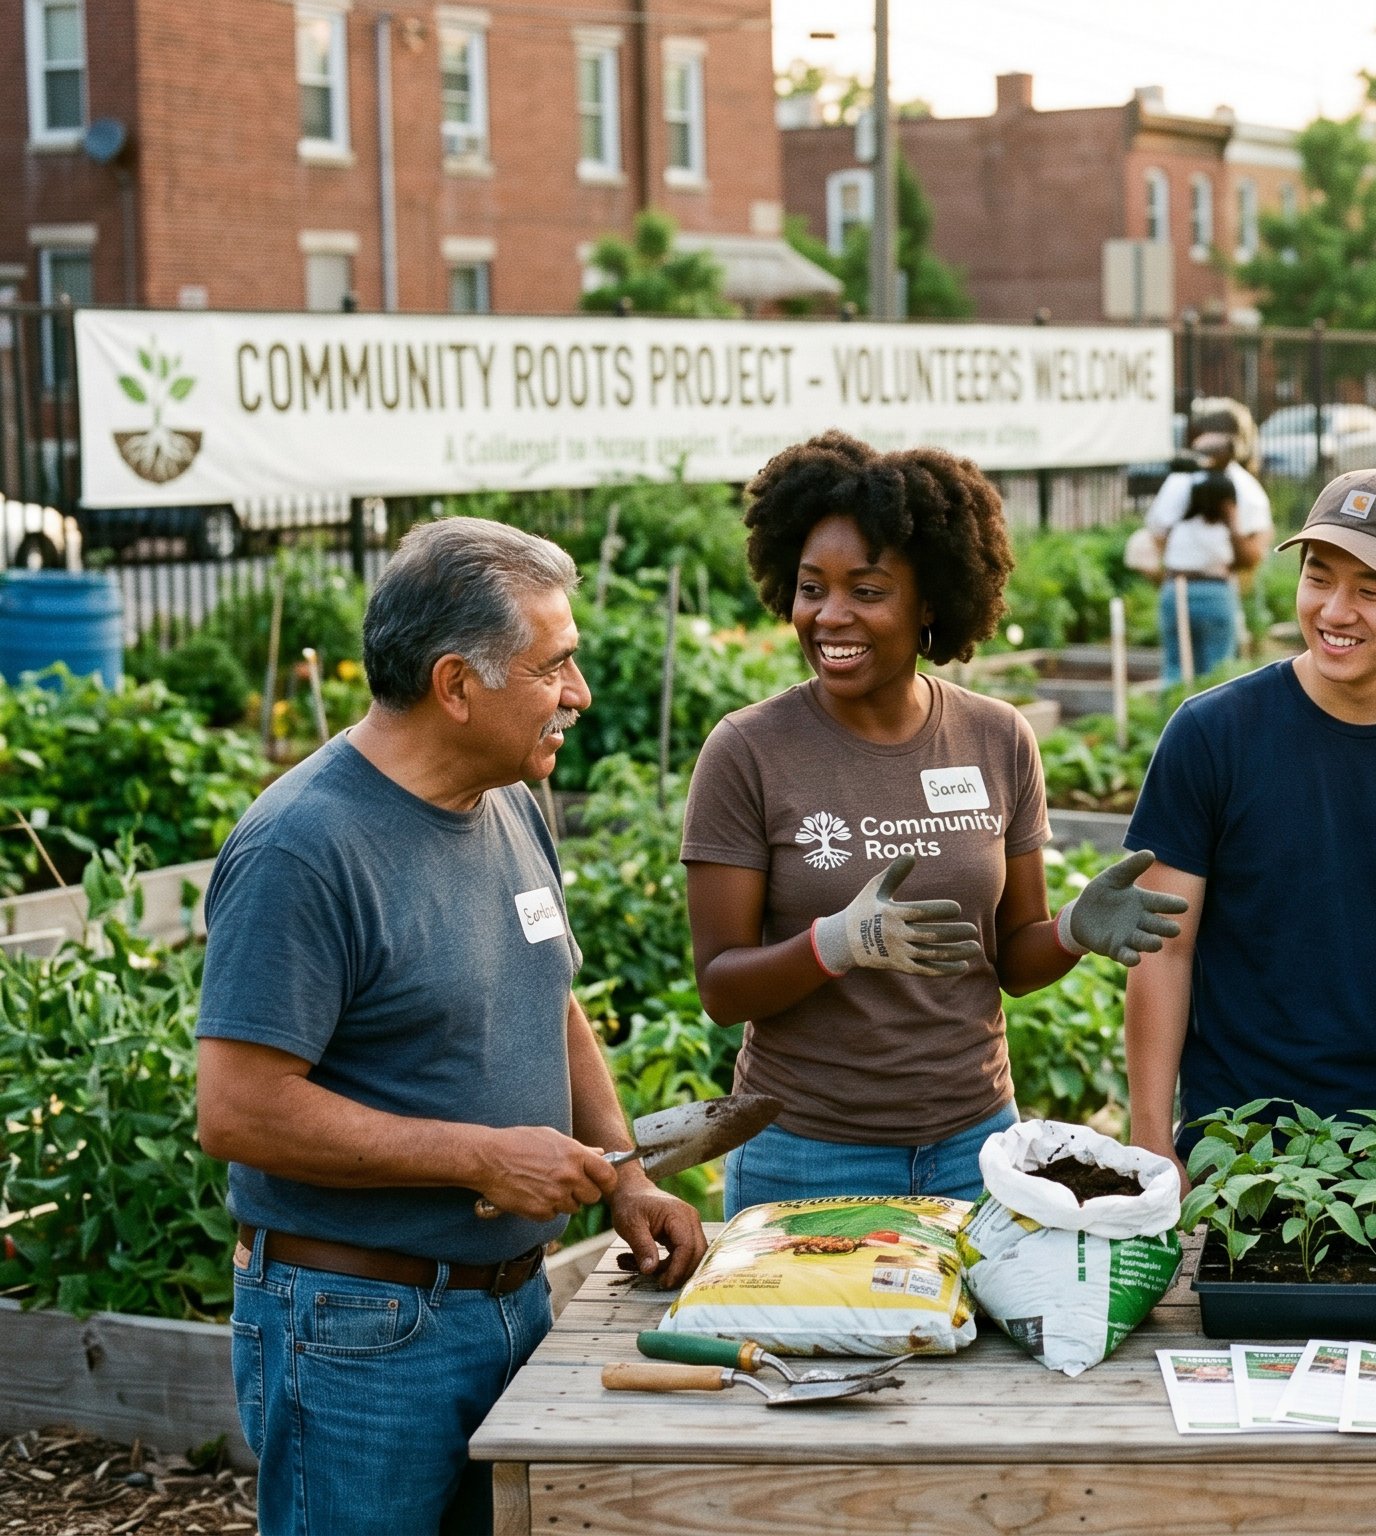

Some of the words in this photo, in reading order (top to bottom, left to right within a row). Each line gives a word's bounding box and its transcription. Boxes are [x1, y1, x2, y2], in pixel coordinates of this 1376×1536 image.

[236, 343, 495, 412] COMMUNITY
[512, 343, 634, 408] ROOTS
[650, 343, 793, 406] PROJECT
[831, 345, 1022, 405] VOLUNTEERS
[1031, 347, 1156, 403] WELCOME
[928, 777, 977, 798] Sarah
[860, 809, 1003, 836] Community
[864, 838, 942, 860] Roots
